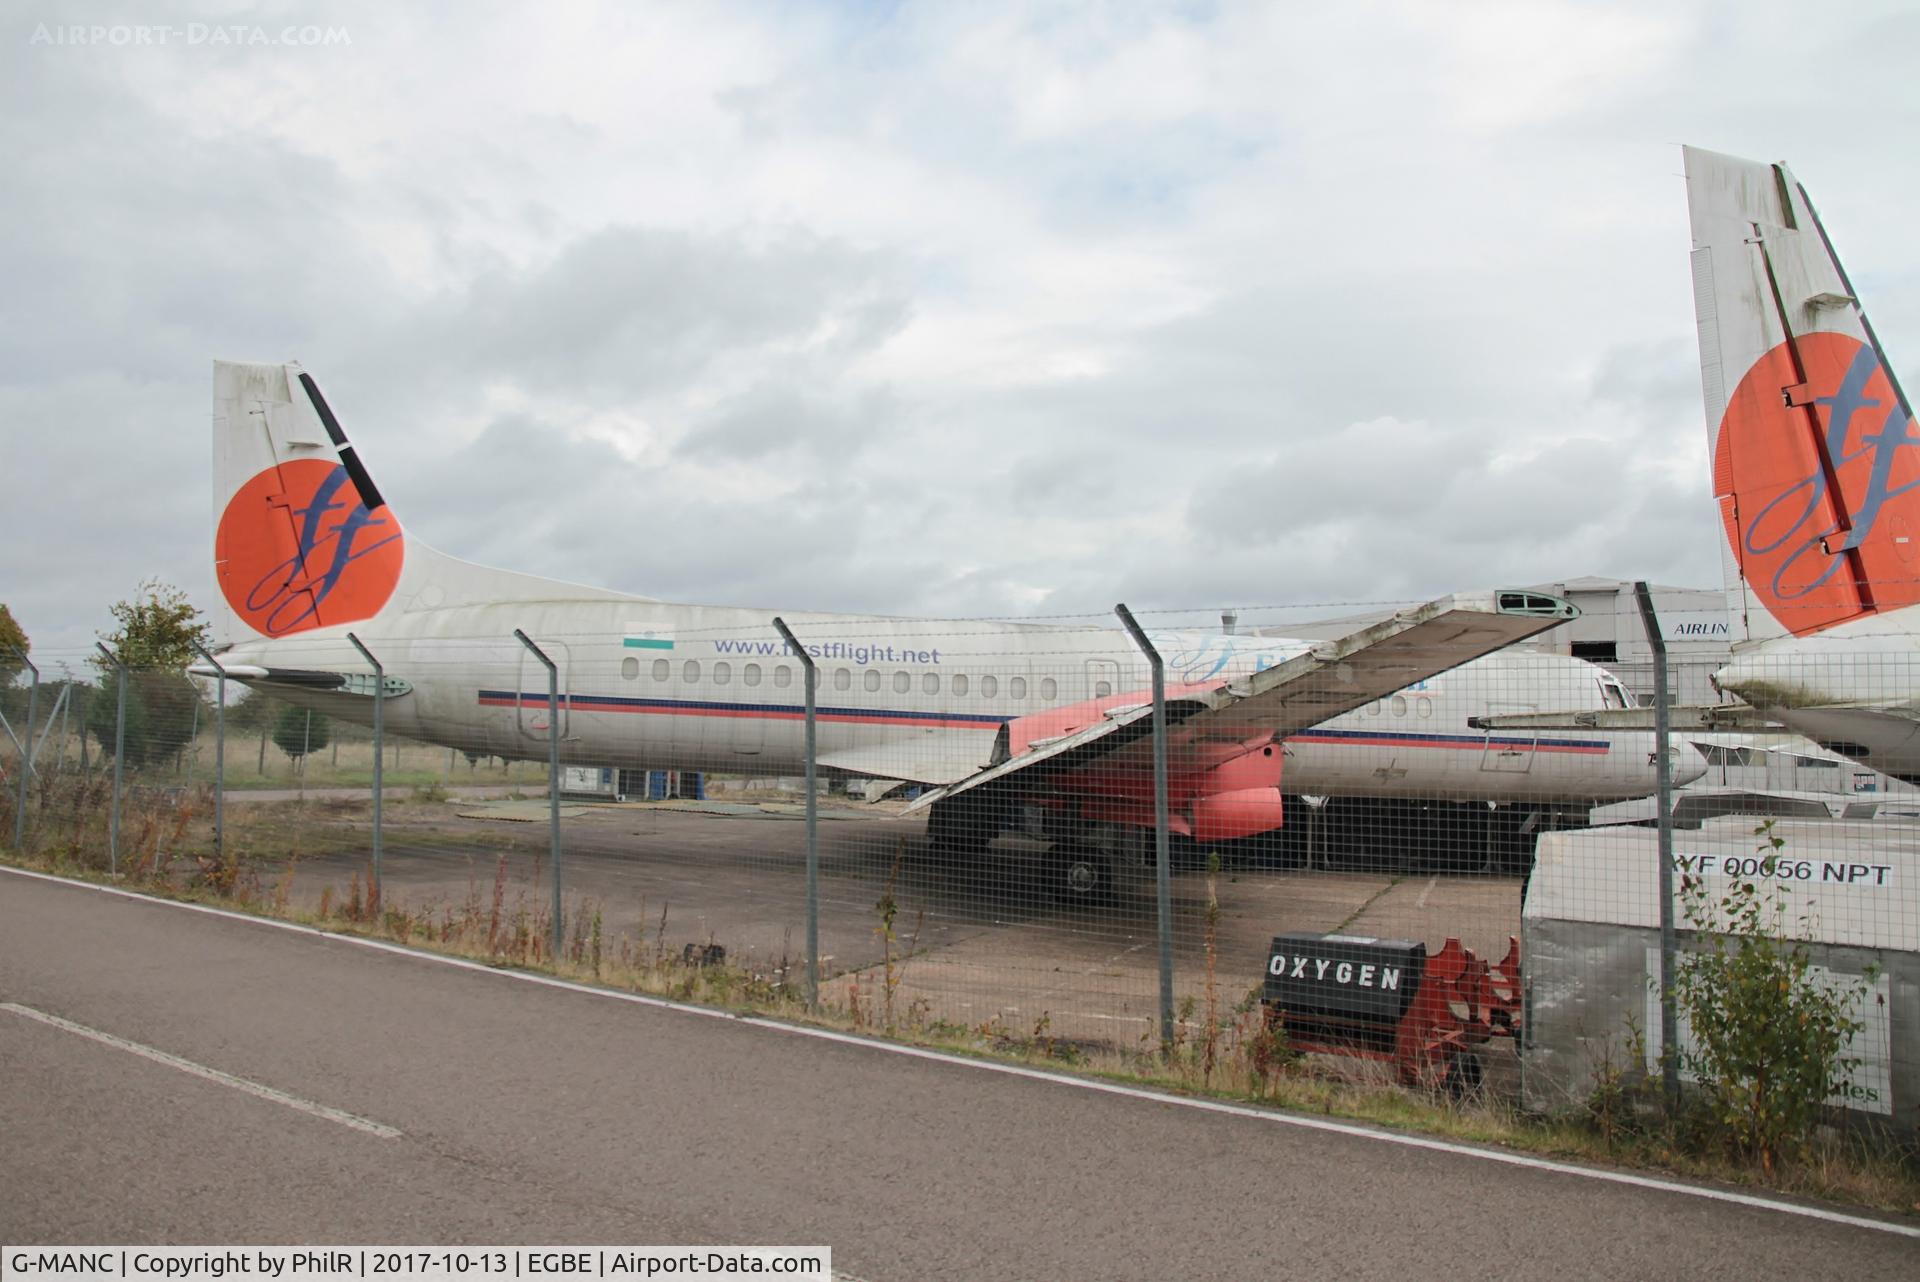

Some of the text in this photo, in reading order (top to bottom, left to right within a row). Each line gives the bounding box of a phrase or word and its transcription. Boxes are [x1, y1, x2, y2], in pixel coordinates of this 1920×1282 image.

[715, 639, 941, 665] www.fstflight.net
[1823, 862, 1892, 885] NPT
[1269, 954, 1399, 991] OXYGEN
